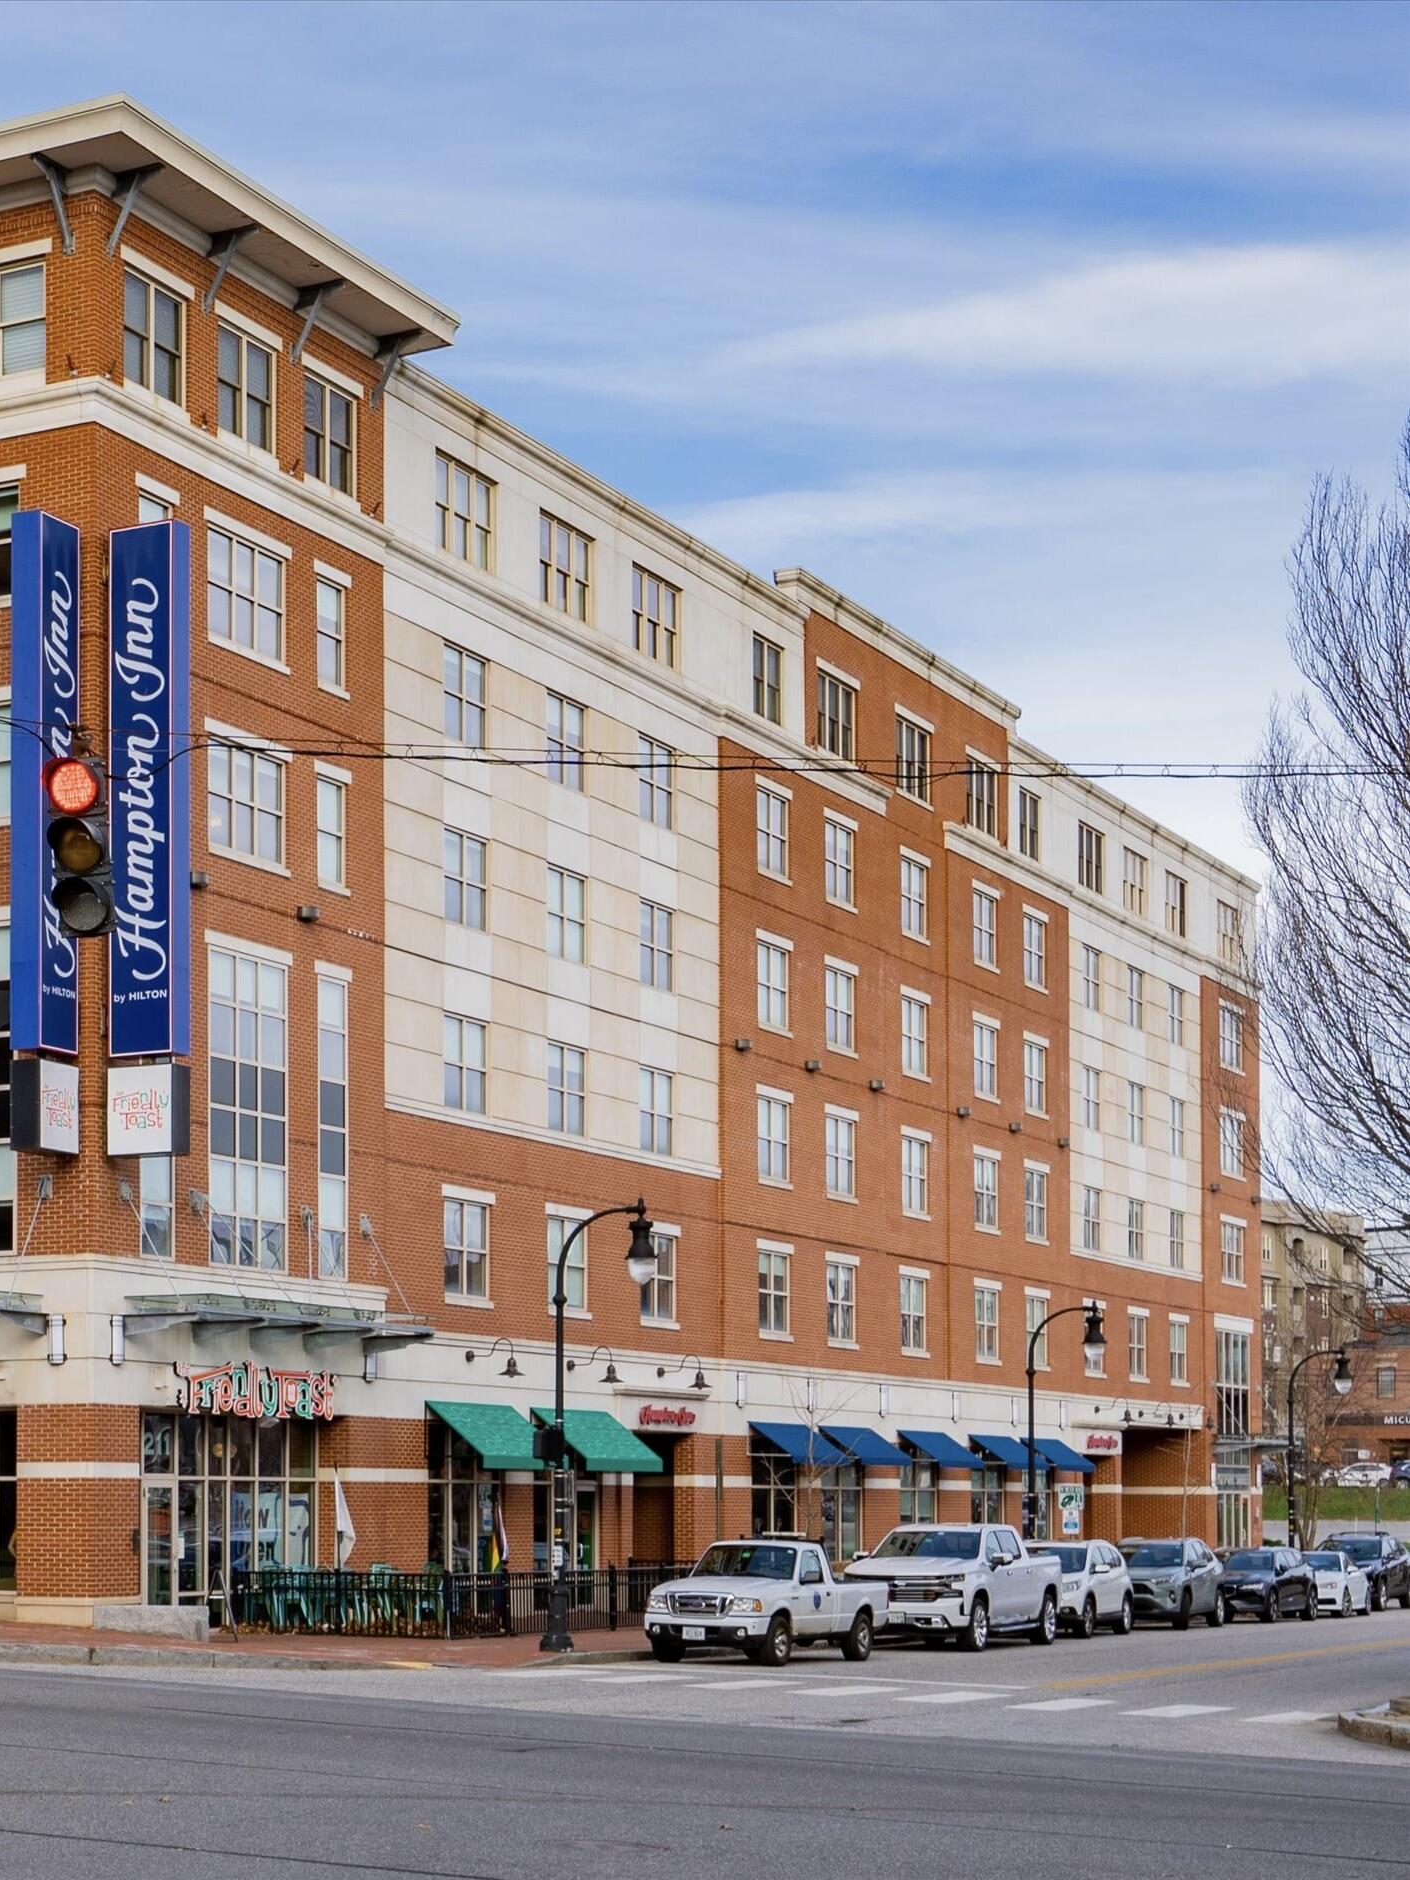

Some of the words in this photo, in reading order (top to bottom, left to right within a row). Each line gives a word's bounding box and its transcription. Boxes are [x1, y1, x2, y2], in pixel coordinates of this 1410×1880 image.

[43, 571, 76, 699] Inn
[114, 578, 166, 702] Inn
[114, 713, 167, 981] Hampton
[42, 984, 51, 996] by
[52, 985, 76, 1000] HILTON
[114, 993, 126, 1004] by
[128, 989, 168, 1001] HILTON
[144, 1431, 171, 1456] 211
